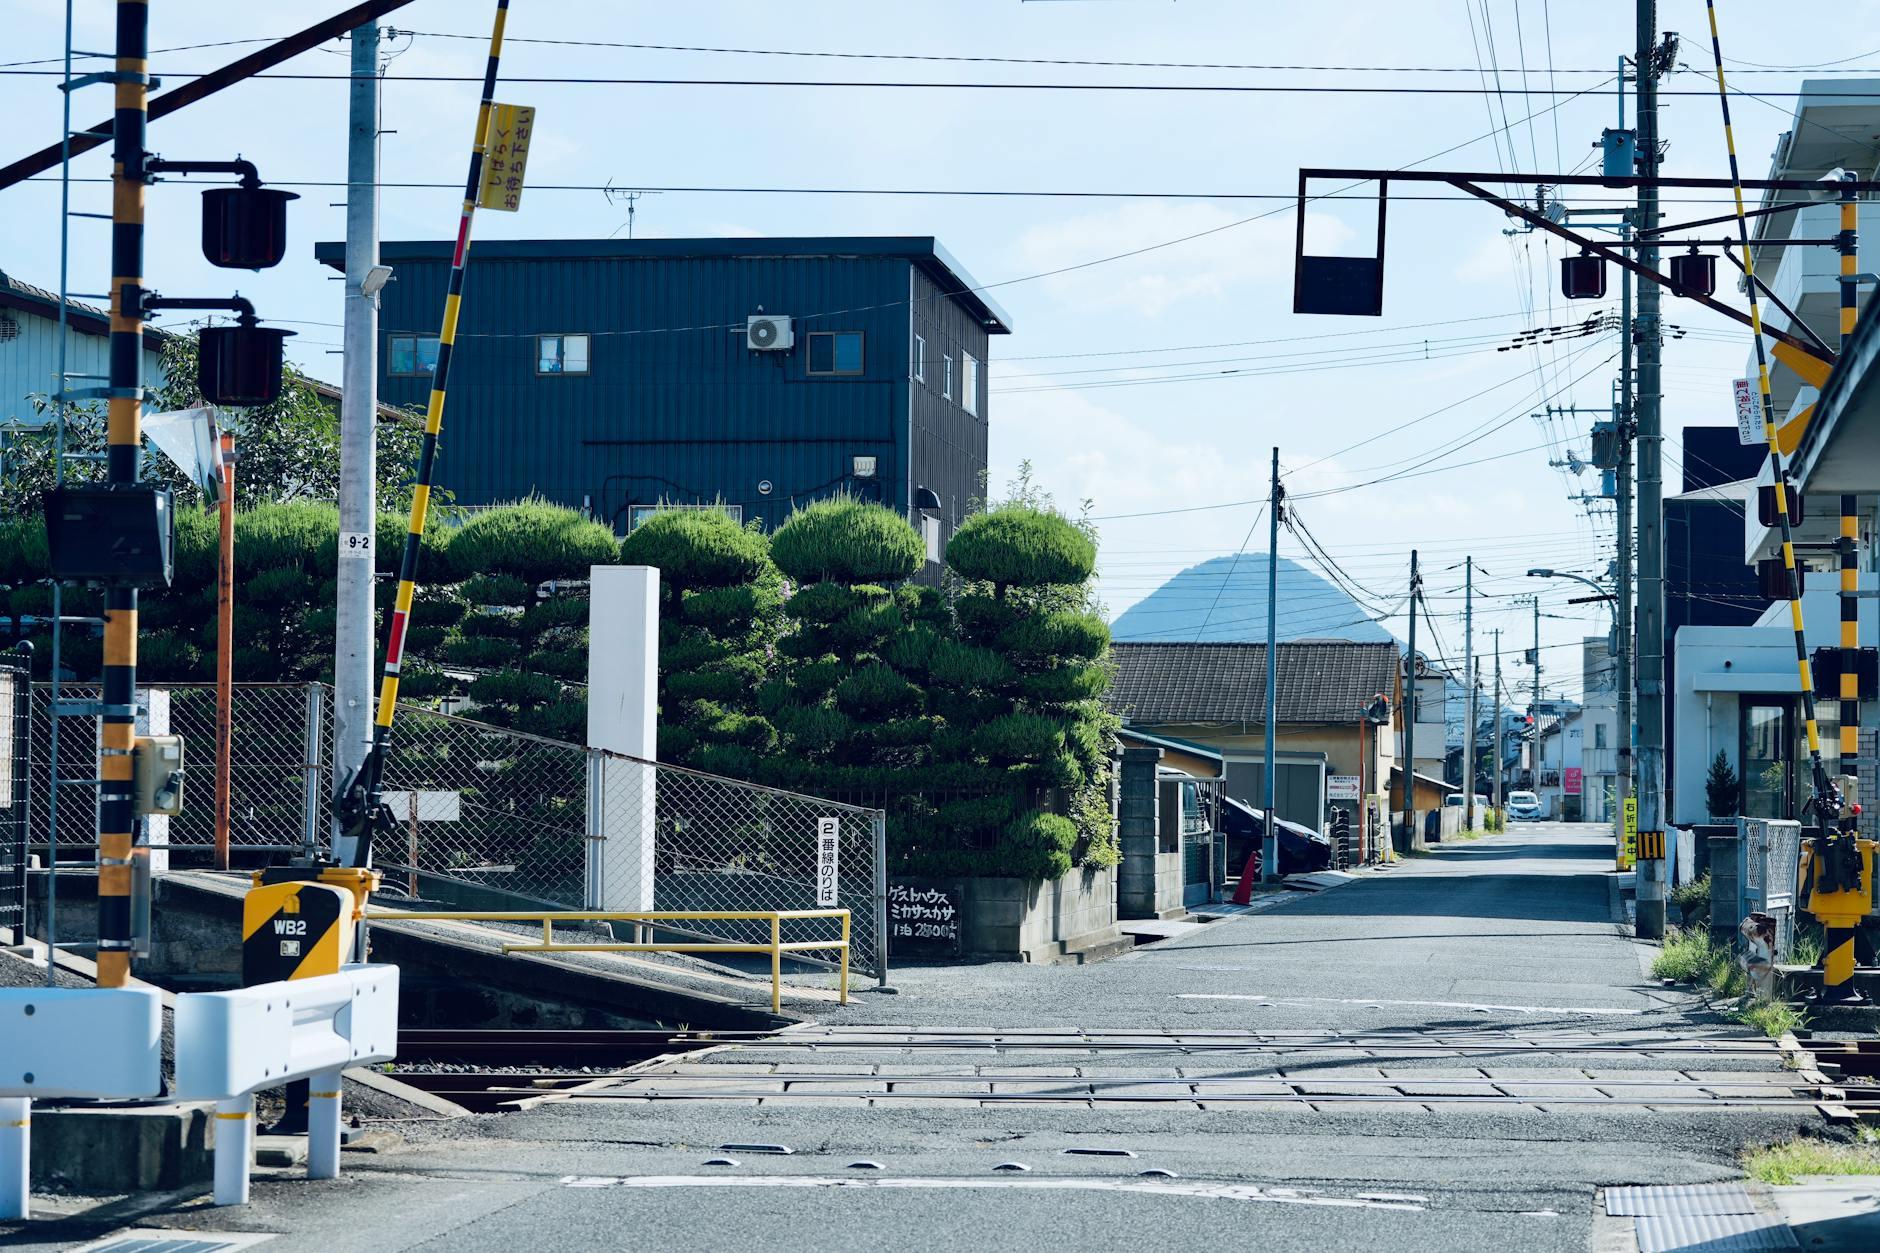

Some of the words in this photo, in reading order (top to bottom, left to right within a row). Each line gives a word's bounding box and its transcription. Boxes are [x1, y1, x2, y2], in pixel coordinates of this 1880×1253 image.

[488, 128, 510, 186] しばらく
[504, 109, 531, 209] お待ち下さい
[349, 535, 369, 549] 9-2
[887, 885, 950, 905] ゲストハウス
[273, 919, 307, 936] WB2
